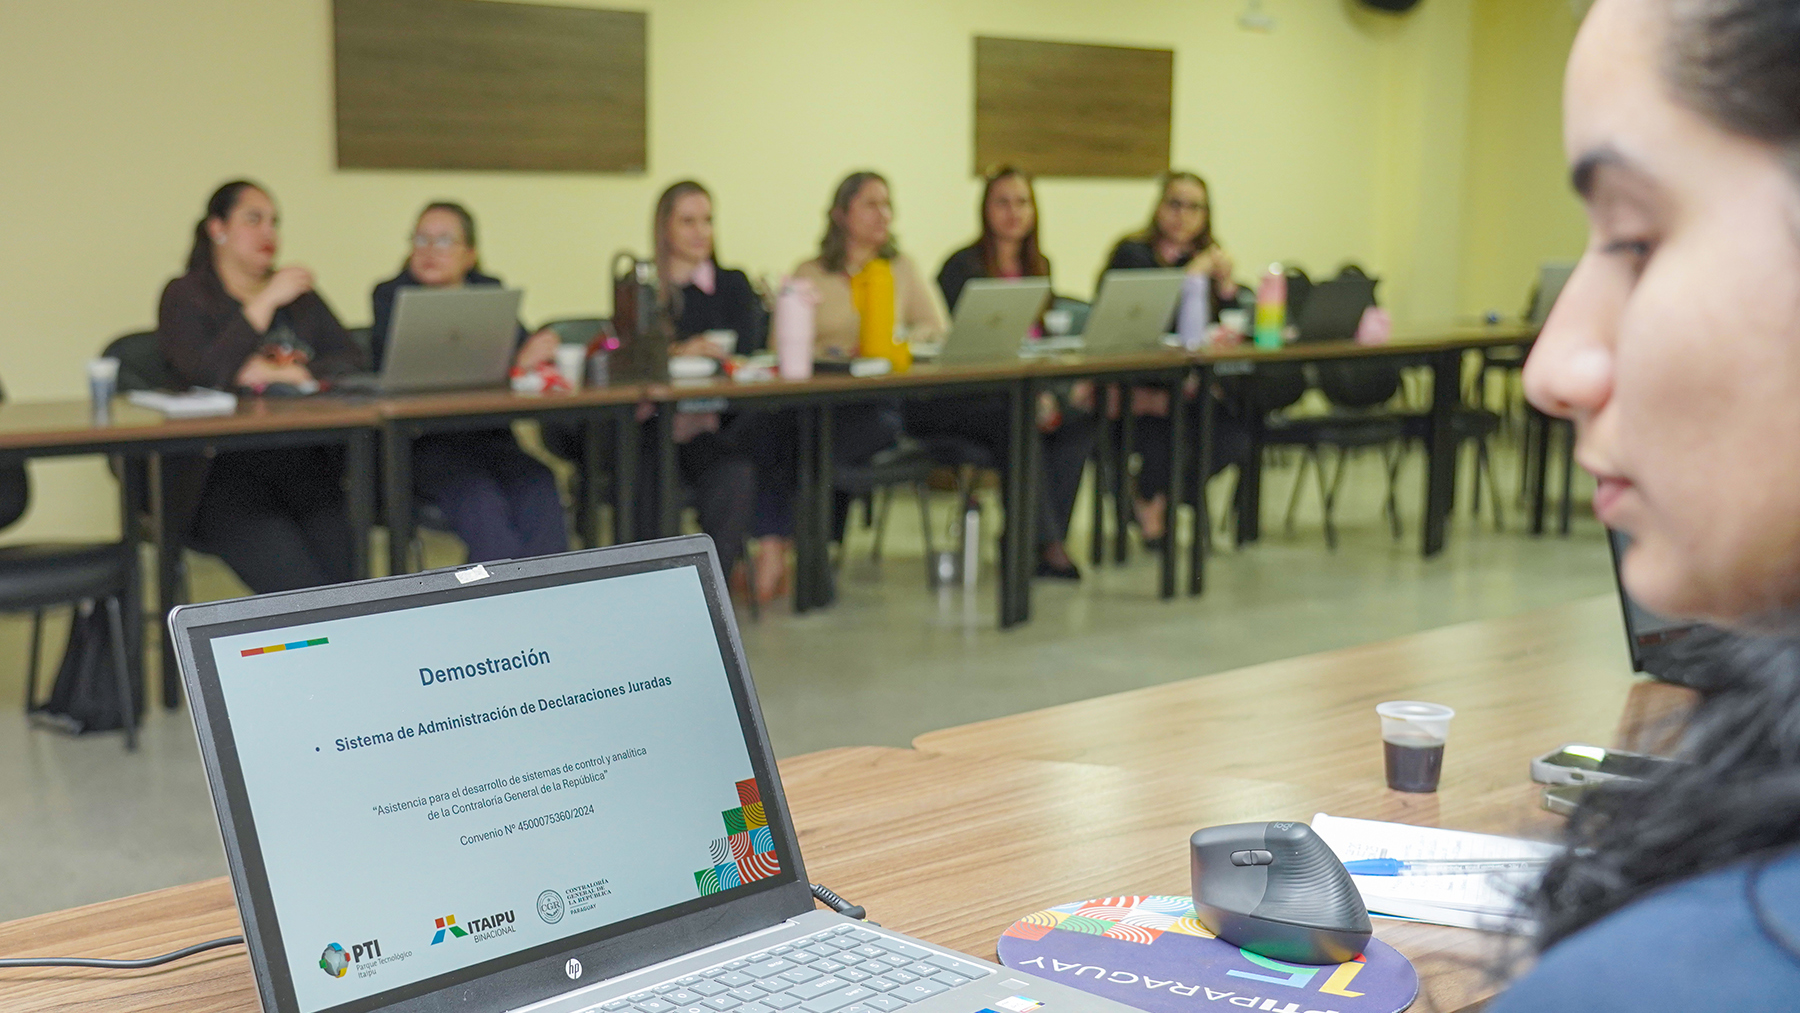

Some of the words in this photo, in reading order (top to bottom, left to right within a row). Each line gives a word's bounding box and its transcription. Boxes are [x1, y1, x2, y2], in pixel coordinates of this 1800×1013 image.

[419, 648, 551, 686] Demostración
[335, 731, 395, 752] Sistema
[397, 727, 414, 740] de
[418, 705, 518, 736] Administración
[520, 702, 536, 715] de
[538, 685, 626, 711] Declaraciones
[627, 676, 672, 694] Juradas
[373, 797, 428, 816] “Asistencia
[429, 792, 450, 806] para
[451, 788, 461, 799] el
[462, 778, 508, 797] desarrollo
[509, 775, 521, 786] de
[522, 767, 561, 783] sistemas
[562, 763, 574, 774] de
[575, 755, 605, 771] control
[605, 756, 611, 766] y
[612, 747, 647, 762] analítica
[427, 810, 440, 821] de
[441, 808, 451, 818] la
[452, 796, 503, 815] Contraloría
[504, 786, 540, 803] General
[541, 784, 552, 795] de
[553, 781, 562, 791] la
[562, 769, 608, 789] República”
[460, 827, 504, 846] Convenio
[518, 804, 595, 832] 4500075360/2024
[1273, 822, 1295, 831] logi
[565, 878, 609, 895] CONTRALORÍA
[566, 889, 595, 900] GENERAL
[541, 900, 560, 912] CGR
[570, 904, 597, 915] PARAGUAY
[467, 910, 516, 935] ITAIPU
[473, 925, 517, 944] BINACIONAL
[352, 939, 382, 963] PTI
[356, 960, 377, 971] Parque
[378, 950, 413, 965] Tecnológico
[358, 969, 377, 979] Itaipu
[568, 959, 580, 979] hp
